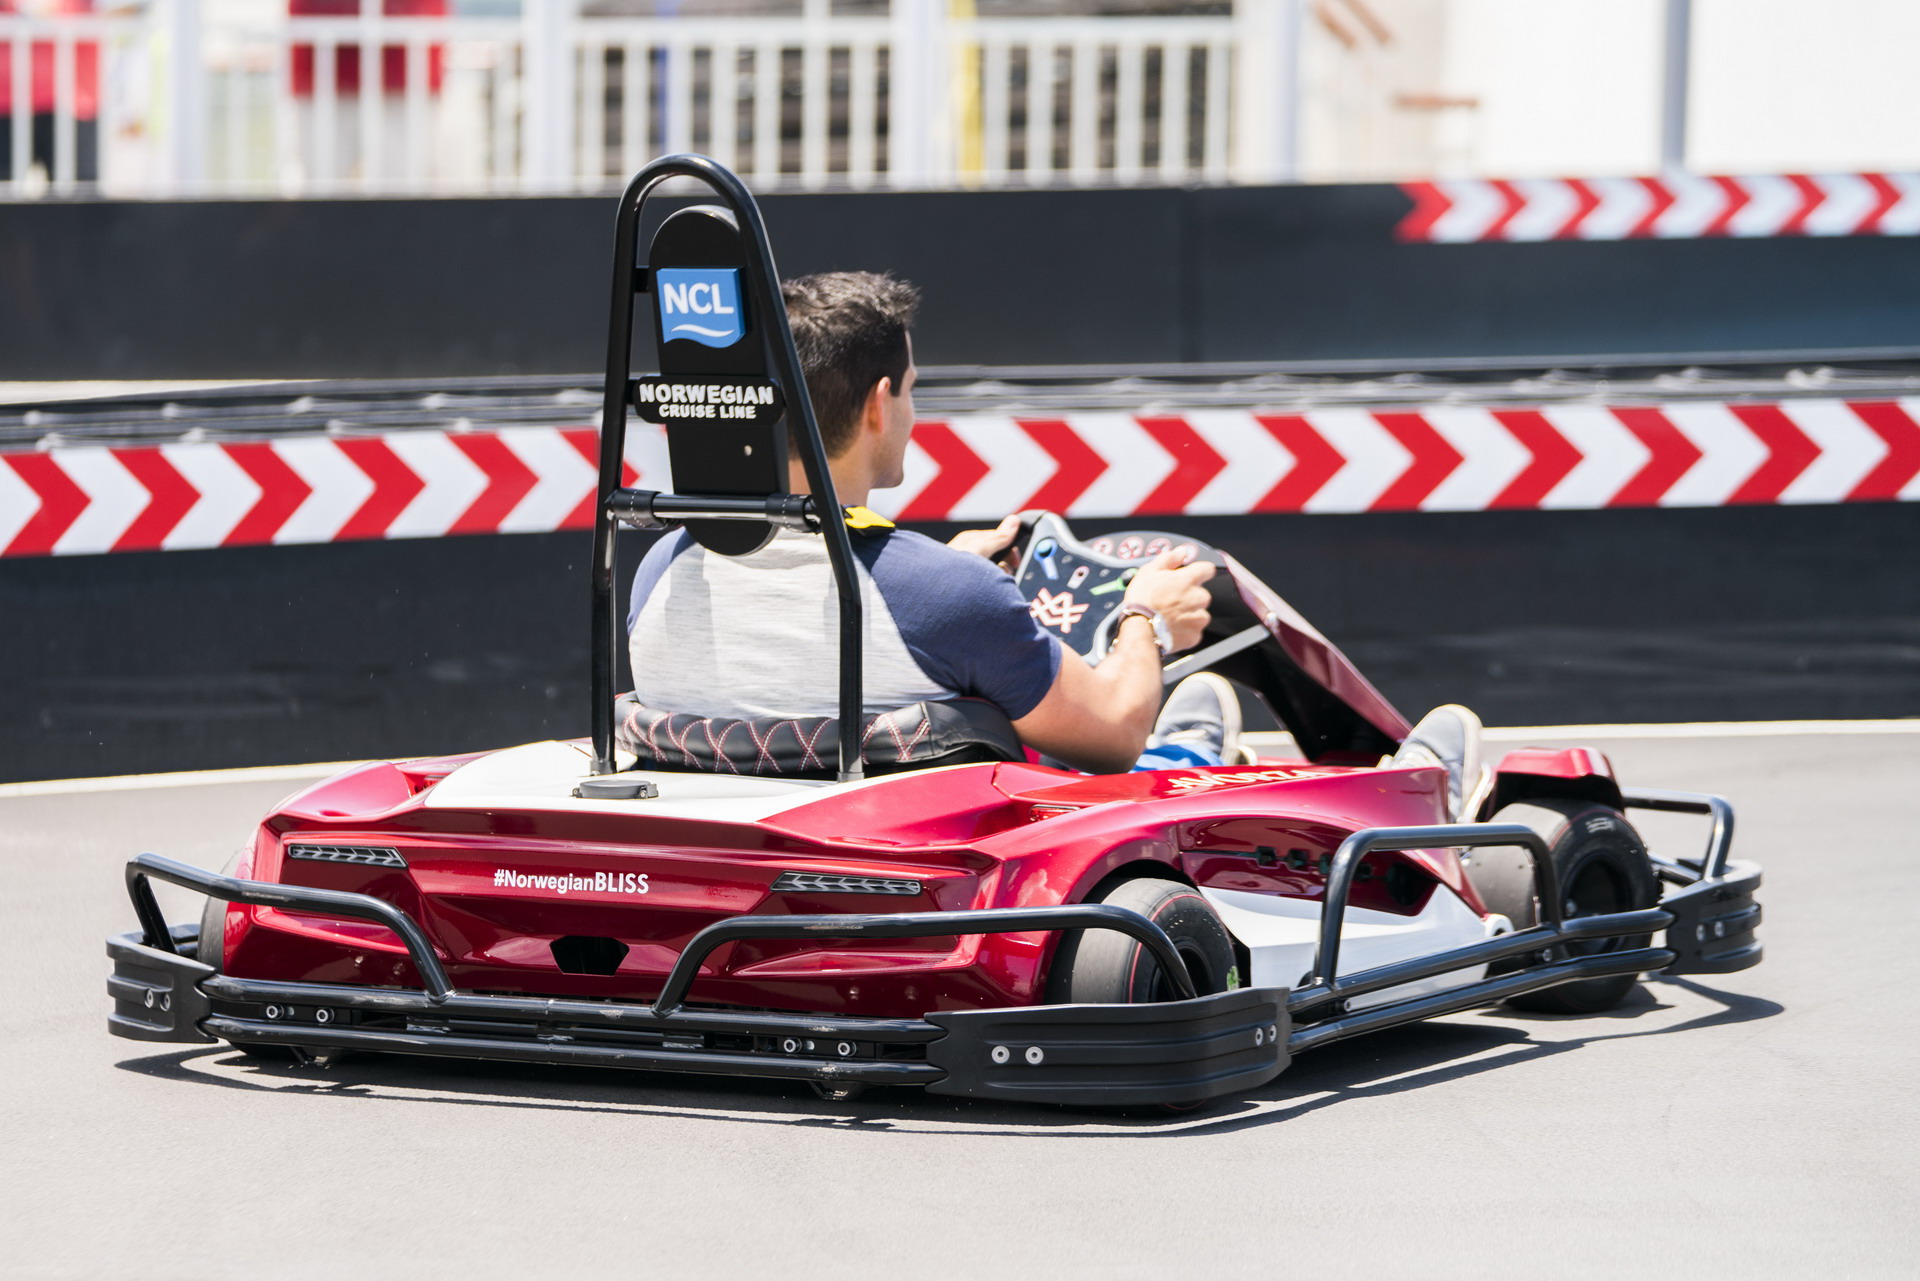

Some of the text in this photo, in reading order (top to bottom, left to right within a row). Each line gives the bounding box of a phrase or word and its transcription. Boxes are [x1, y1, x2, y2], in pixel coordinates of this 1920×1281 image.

[663, 283, 735, 315] NCL
[639, 384, 774, 405] NORWEGIAN
[658, 404, 757, 419] CRUISE LINE
[494, 869, 649, 894] #NorwegianBLISS
